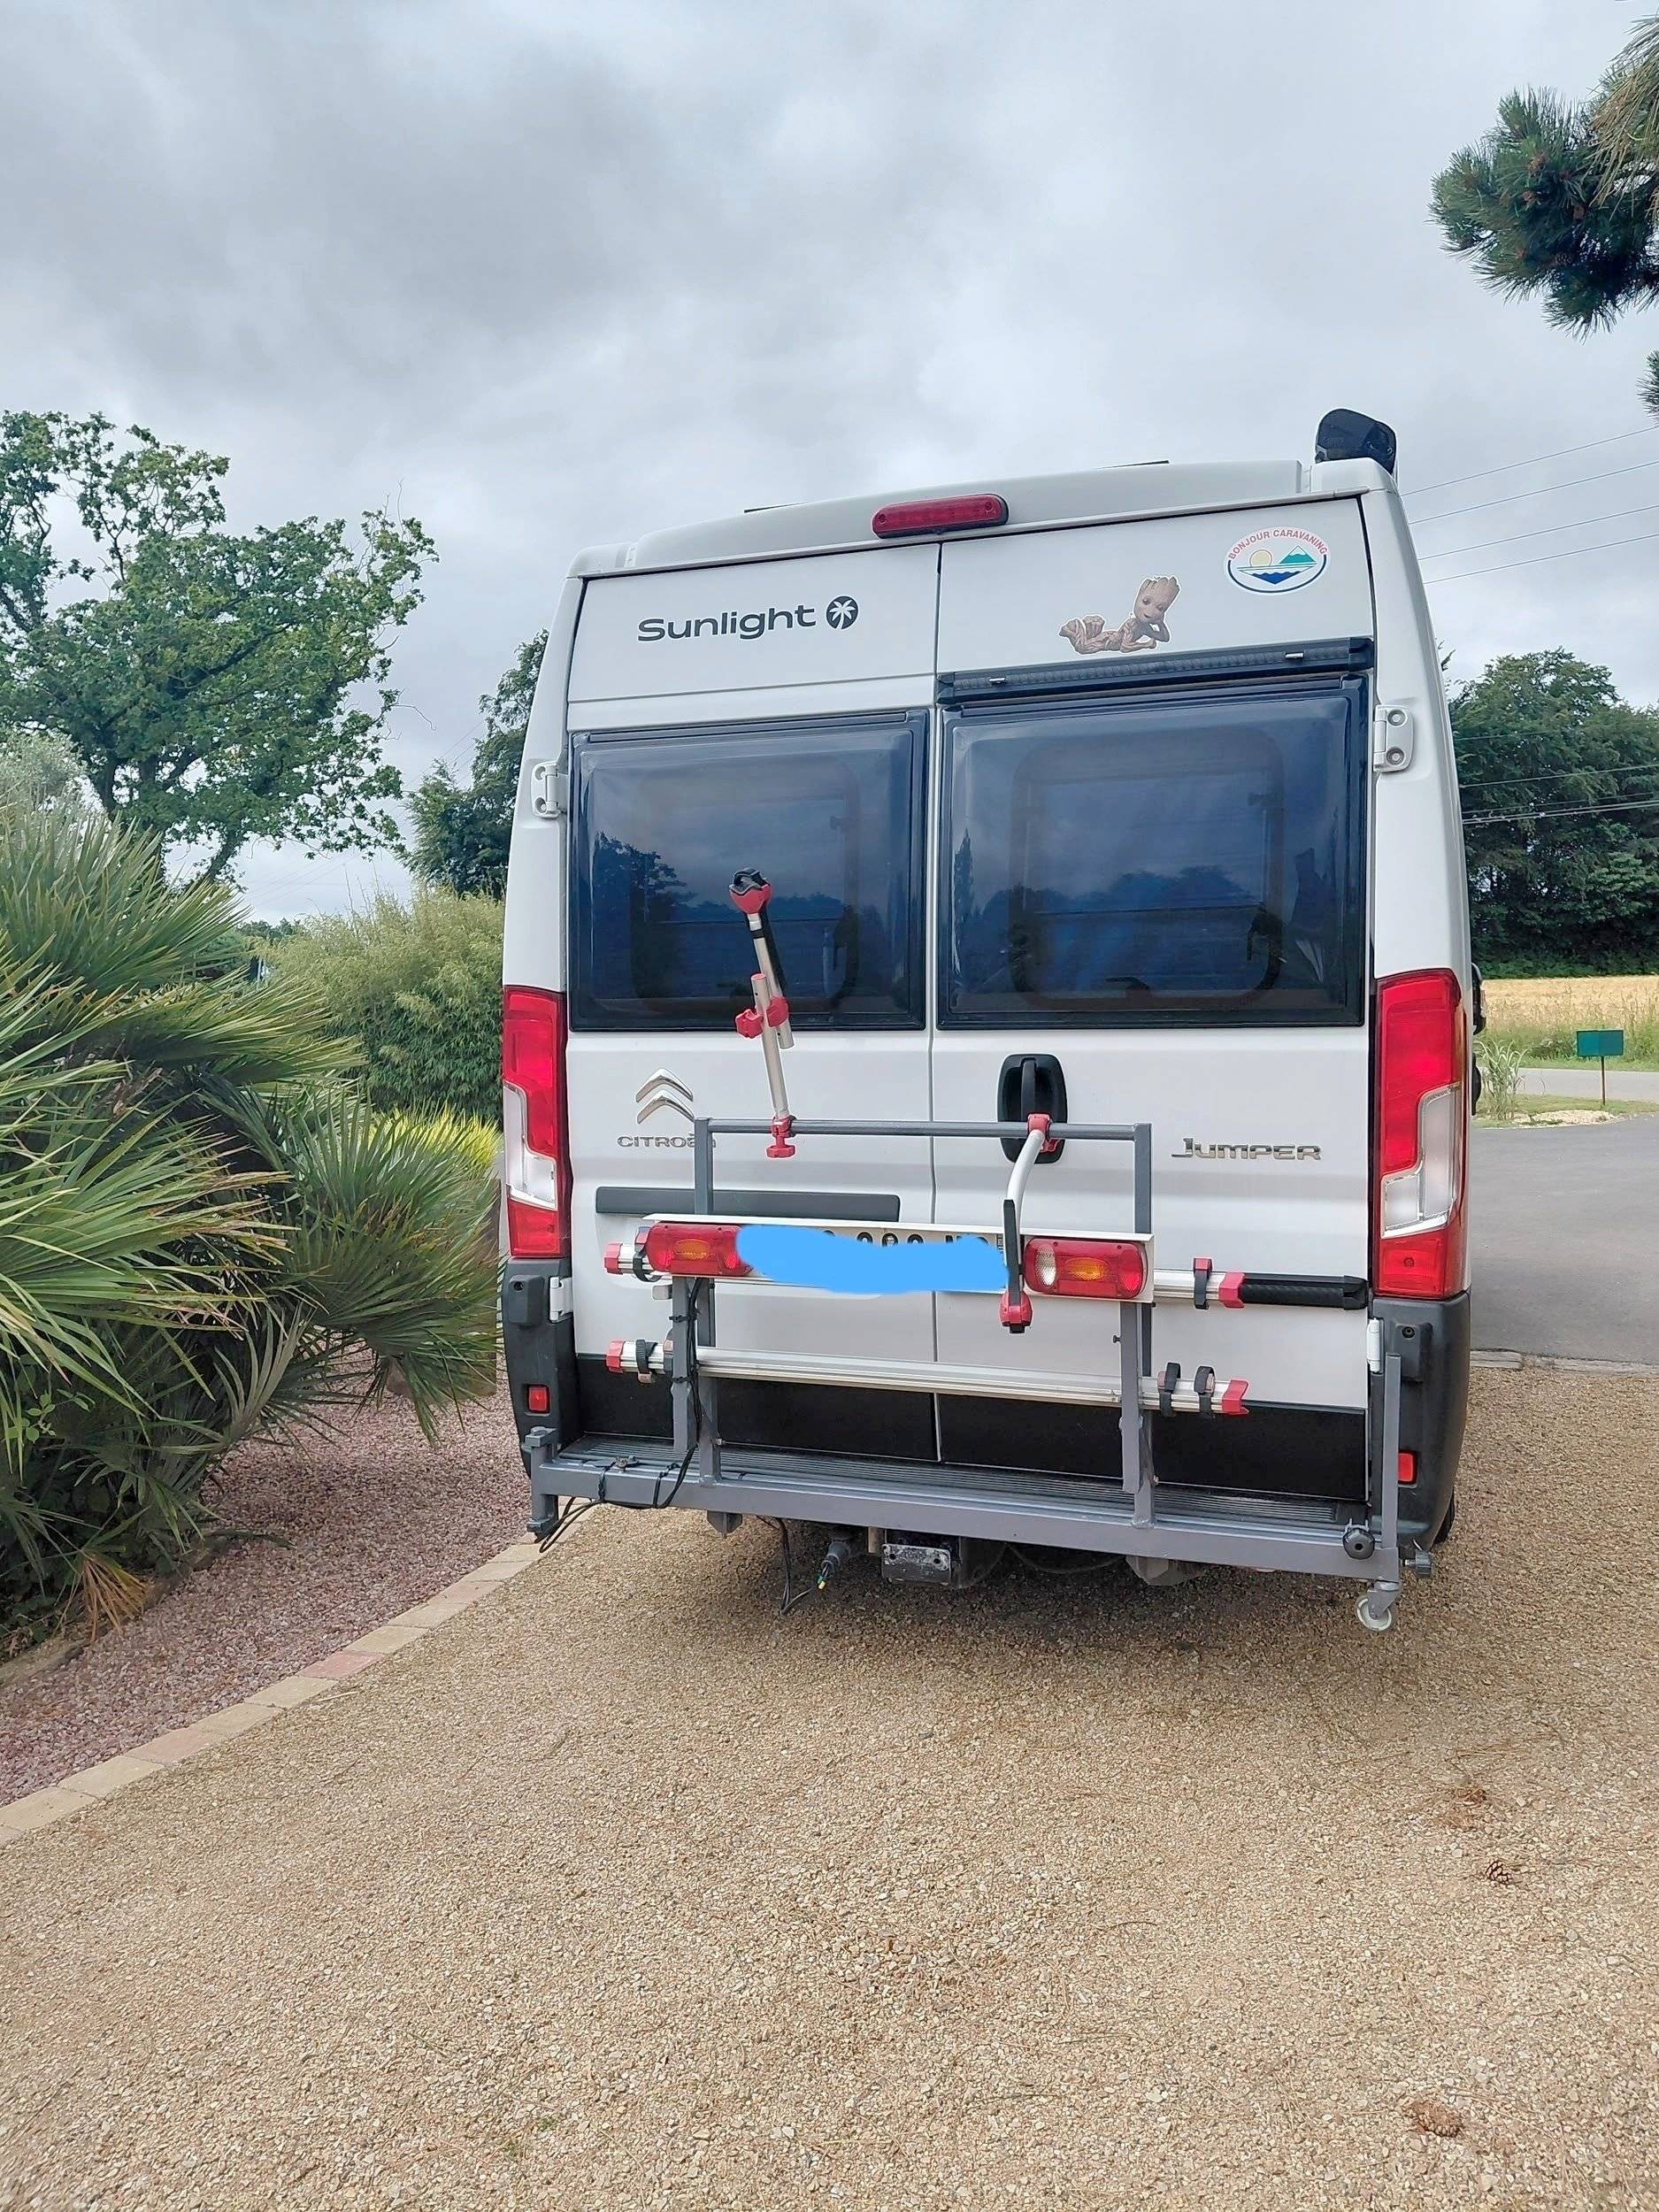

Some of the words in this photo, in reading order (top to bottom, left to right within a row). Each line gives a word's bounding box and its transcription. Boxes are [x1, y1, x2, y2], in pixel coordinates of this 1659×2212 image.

[1228, 531, 1271, 560] BONJOUR
[1272, 529, 1328, 555] CARAVANING
[638, 604, 817, 641] Sunlight
